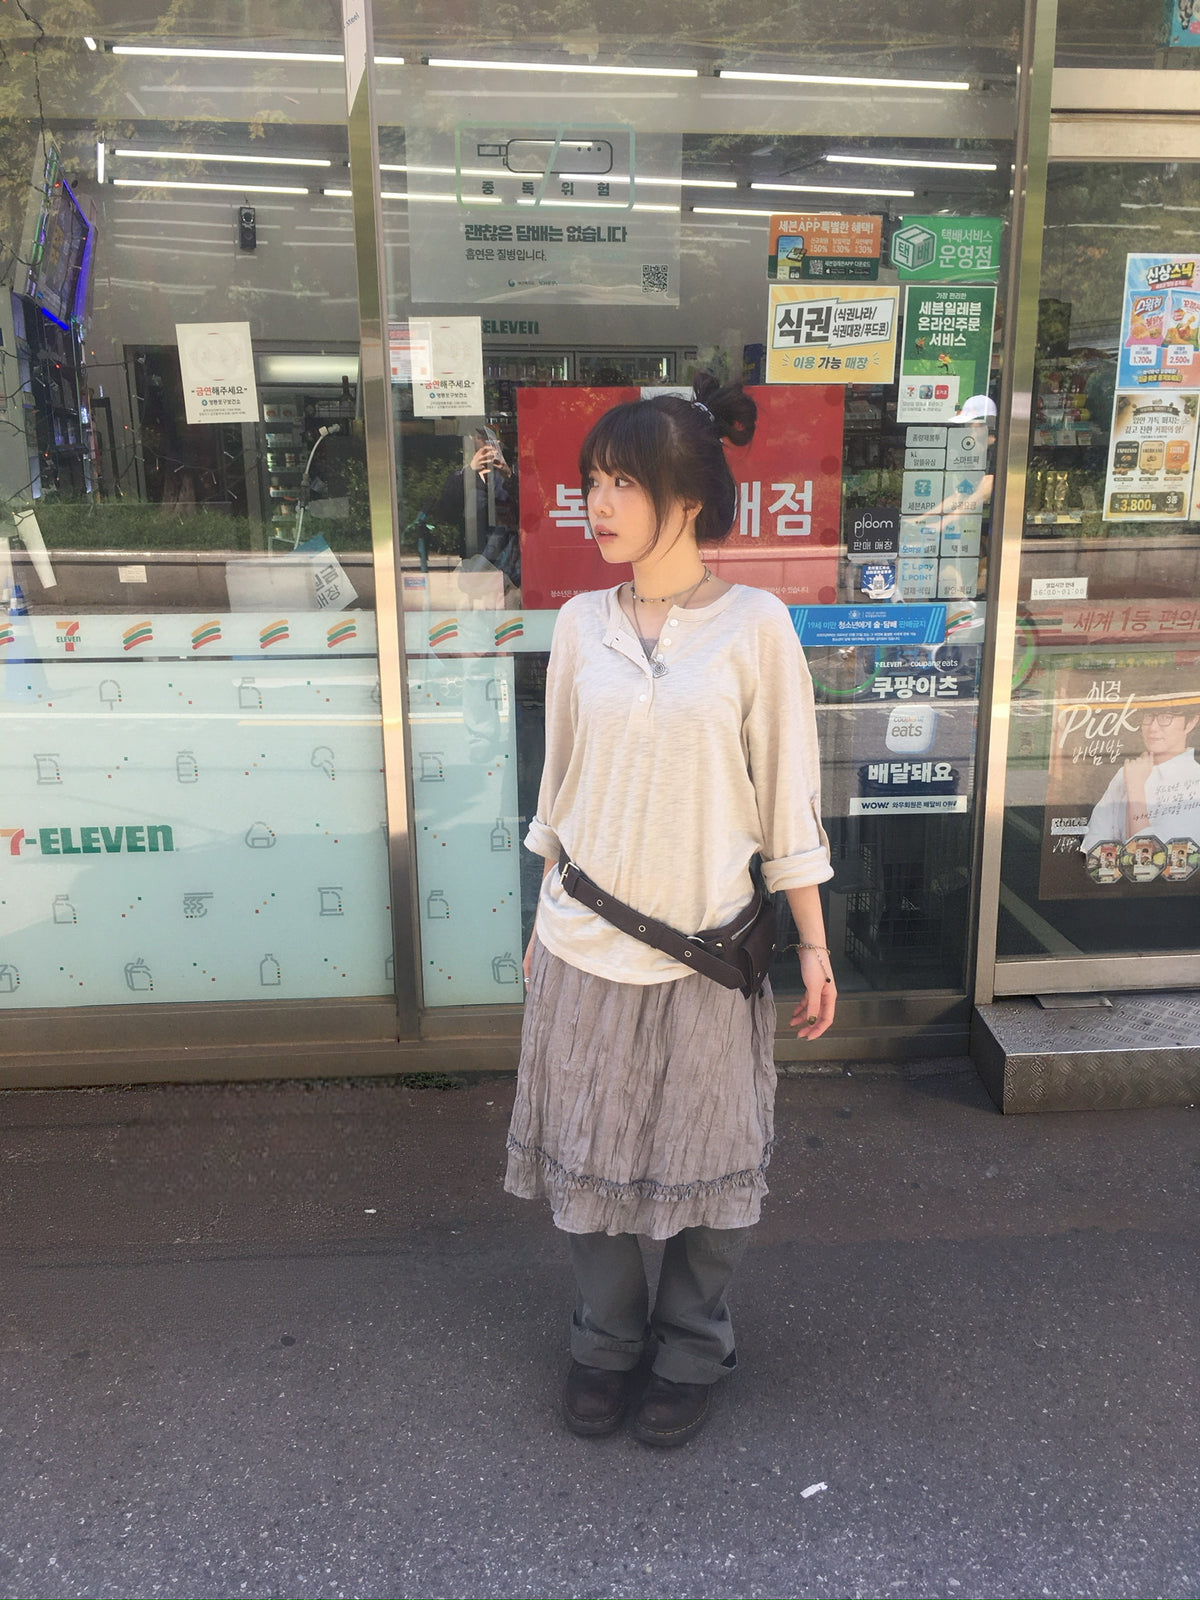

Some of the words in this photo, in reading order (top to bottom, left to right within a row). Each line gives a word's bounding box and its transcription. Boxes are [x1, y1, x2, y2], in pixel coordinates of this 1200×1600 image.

[561, 181, 574, 196] 위
[597, 182, 610, 197] 험
[464, 223, 513, 242] 괜찮은
[516, 224, 564, 242] 담배는
[566, 225, 628, 243] 없습니다
[941, 228, 993, 243] 택배서비스
[465, 248, 496, 261] 흡연은
[496, 249, 547, 262] 질병입니다.
[939, 244, 992, 269] 운영점
[834, 306, 878, 323] (식권나라/
[919, 301, 982, 316] 세븐일레븐
[777, 306, 833, 344] 식권
[832, 321, 889, 338] 식권대장/푸드콘)
[918, 316, 981, 332] 온라인주문
[929, 333, 967, 347] 서비스
[793, 356, 816, 369] 이용
[817, 356, 842, 370] 가능
[845, 356, 869, 370] 매장
[854, 512, 894, 539] ploom
[853, 540, 871, 550] 판매
[874, 539, 893, 550] 매장
[838, 620, 872, 630] 청소년에게
[1073, 610, 1114, 633] 세계
[1121, 606, 1152, 633] 1등
[1158, 608, 1200, 631] 편의
[942, 659, 958, 667] eats
[871, 675, 959, 699] 쿠팡이츠
[1058, 693, 1140, 749] Pick
[891, 723, 923, 738] eats
[867, 762, 954, 784] 배달돼요
[861, 801, 890, 809] WOW!
